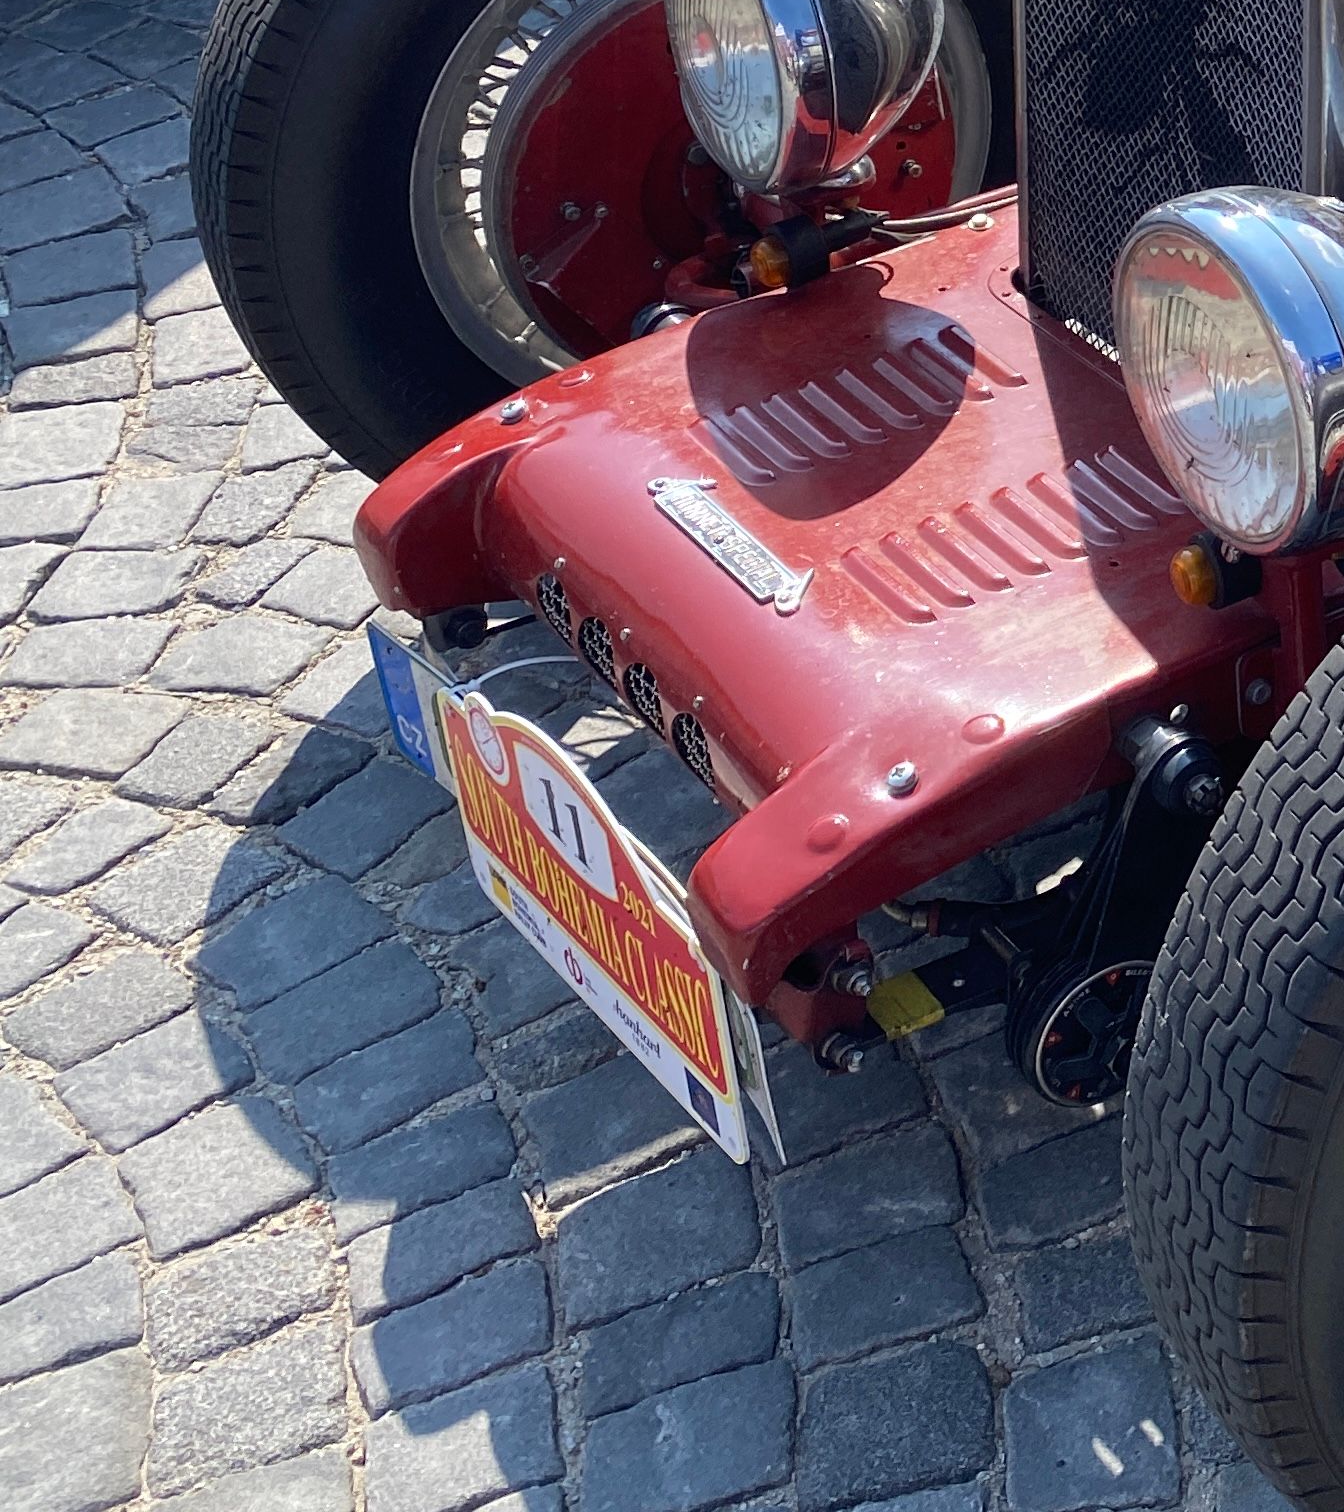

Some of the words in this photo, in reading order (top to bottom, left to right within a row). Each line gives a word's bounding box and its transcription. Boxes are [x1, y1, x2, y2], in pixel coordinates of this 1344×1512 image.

[397, 714, 428, 757] CZ
[539, 777, 592, 874] 11
[454, 734, 530, 879] SOUTH
[530, 833, 629, 986] BOHEMIA
[625, 930, 720, 1079] CLASSIC
[620, 881, 657, 937] 2021
[613, 999, 661, 1059] hanhart
